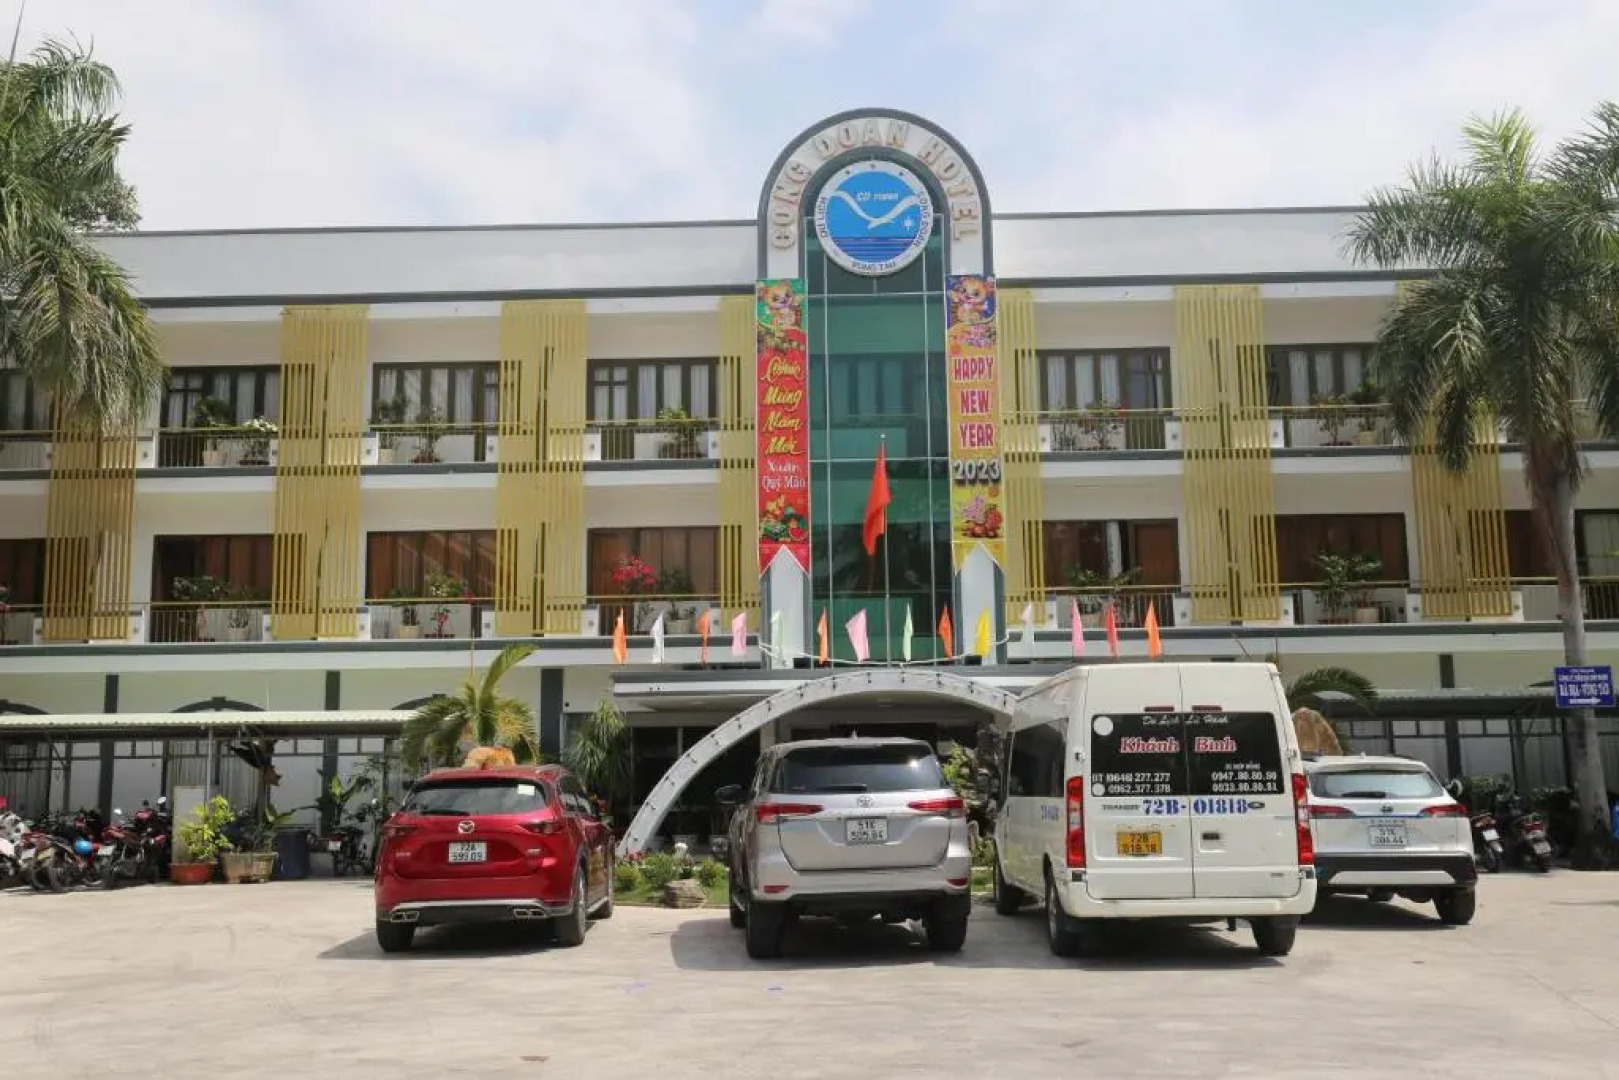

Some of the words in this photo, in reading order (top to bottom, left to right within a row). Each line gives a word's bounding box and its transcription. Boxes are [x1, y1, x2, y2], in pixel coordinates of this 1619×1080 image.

[917, 142, 978, 242] HOTEL
[954, 356, 994, 381] HAPPY
[960, 389, 989, 414] NEW
[959, 423, 994, 448] YEAR
[953, 459, 1001, 483] 2023
[1120, 736, 1180, 754] Khánh
